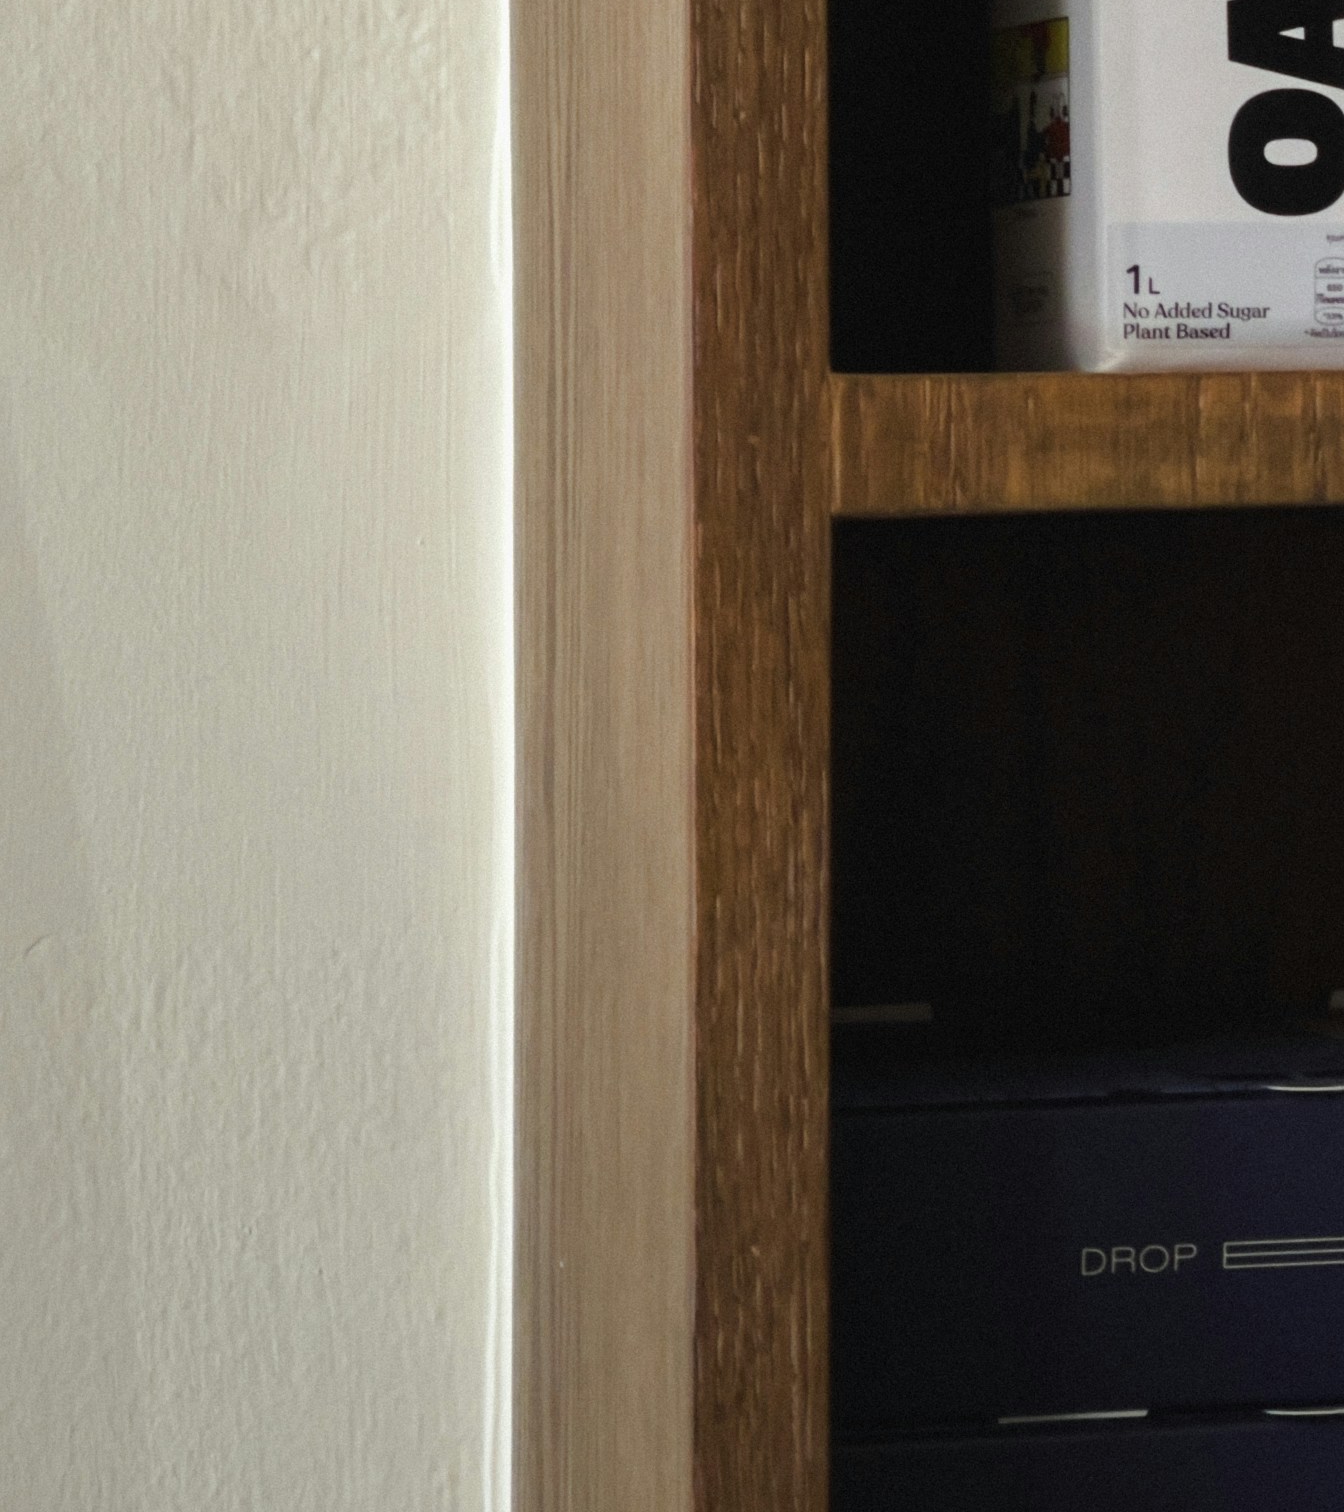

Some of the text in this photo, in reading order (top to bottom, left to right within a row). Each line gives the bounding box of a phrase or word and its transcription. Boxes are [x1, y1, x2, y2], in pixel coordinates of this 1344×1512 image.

[1123, 302, 1270, 325] No Added Sugar
[1123, 322, 1231, 340] Plant Based
[1081, 1242, 1198, 1277] DROP
